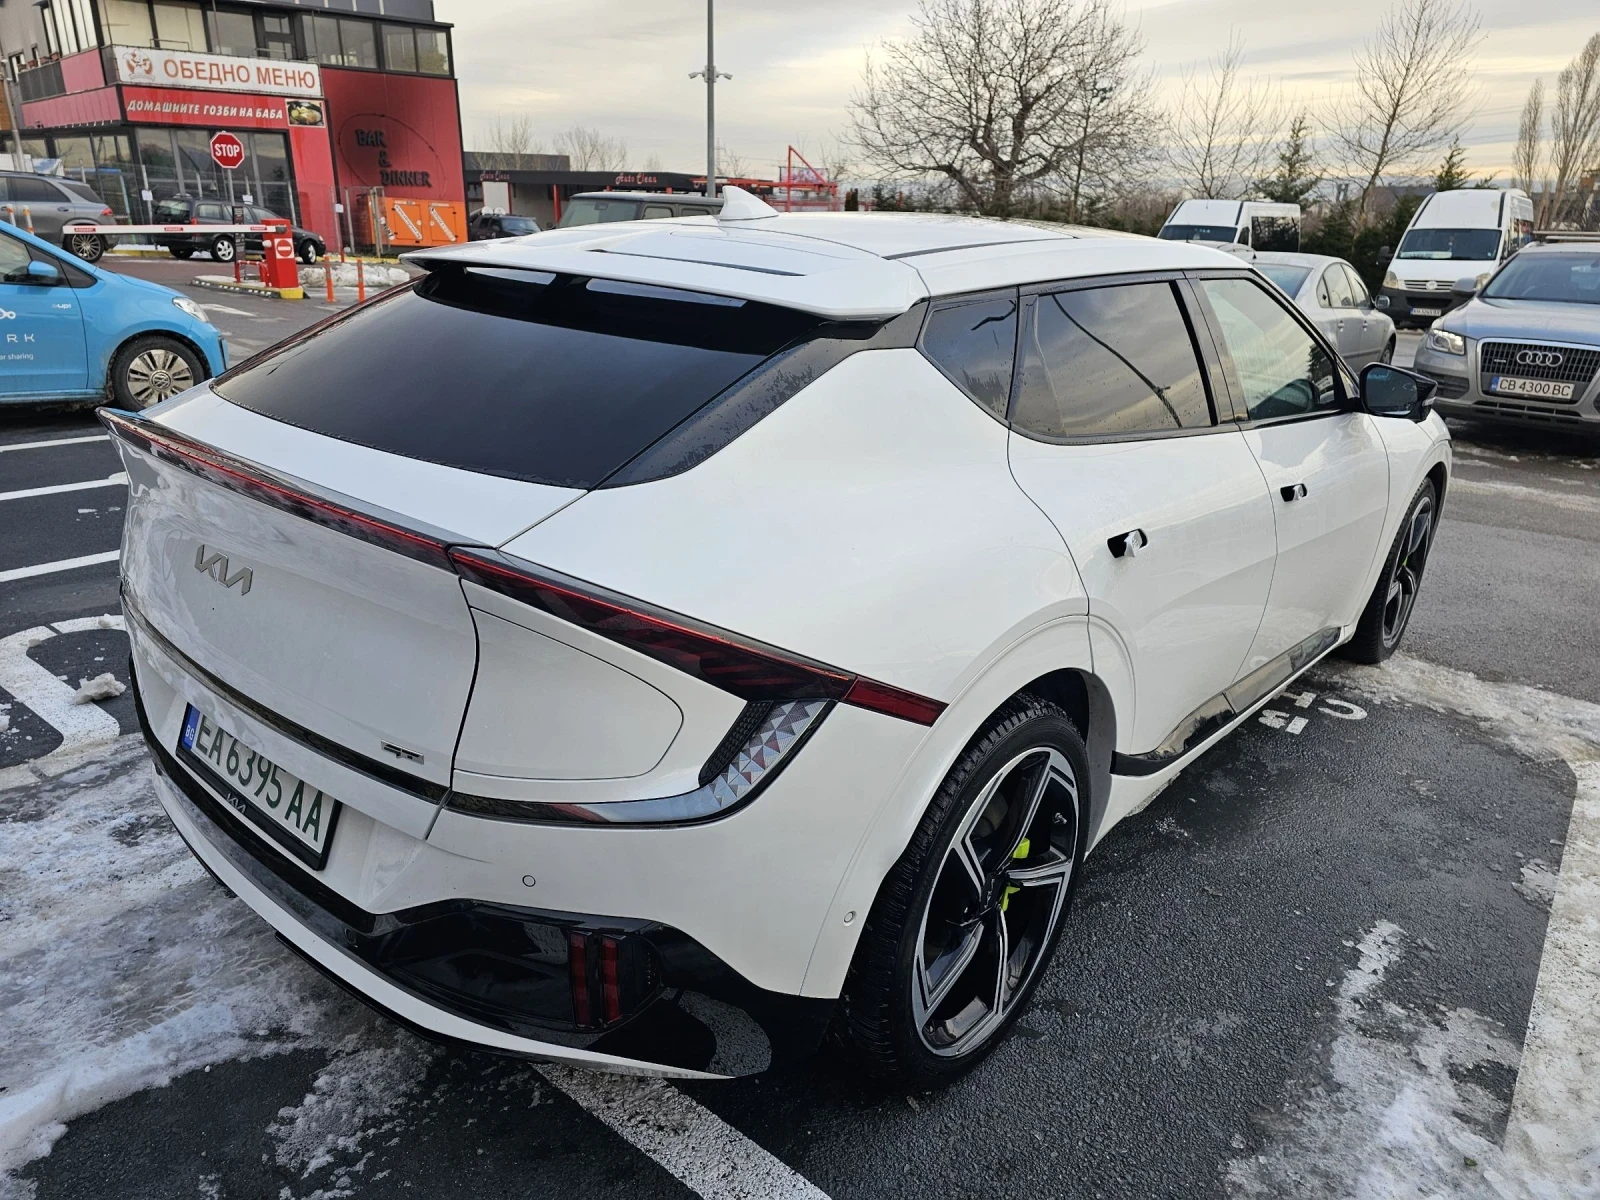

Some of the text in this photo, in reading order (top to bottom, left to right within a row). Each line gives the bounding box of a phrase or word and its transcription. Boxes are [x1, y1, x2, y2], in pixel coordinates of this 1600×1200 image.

[163, 59, 315, 89] ОБЕДНО МЕНЮ
[127, 99, 283, 119] ДОМАШНИТЕ ГОЗБИ НА БАБА
[355, 129, 387, 148] BAR
[214, 144, 240, 157] STOP
[378, 151, 391, 168] &
[380, 170, 432, 188] DINNER
[615, 172, 657, 185] Auto Clean
[8, 353, 34, 361] sharing
[1499, 379, 1516, 390] CB
[1518, 381, 1550, 394] 4300
[1552, 385, 1571, 397] BC
[194, 544, 253, 596] KIA
[185, 725, 195, 741] BG
[196, 714, 324, 843] EA 6395 AA
